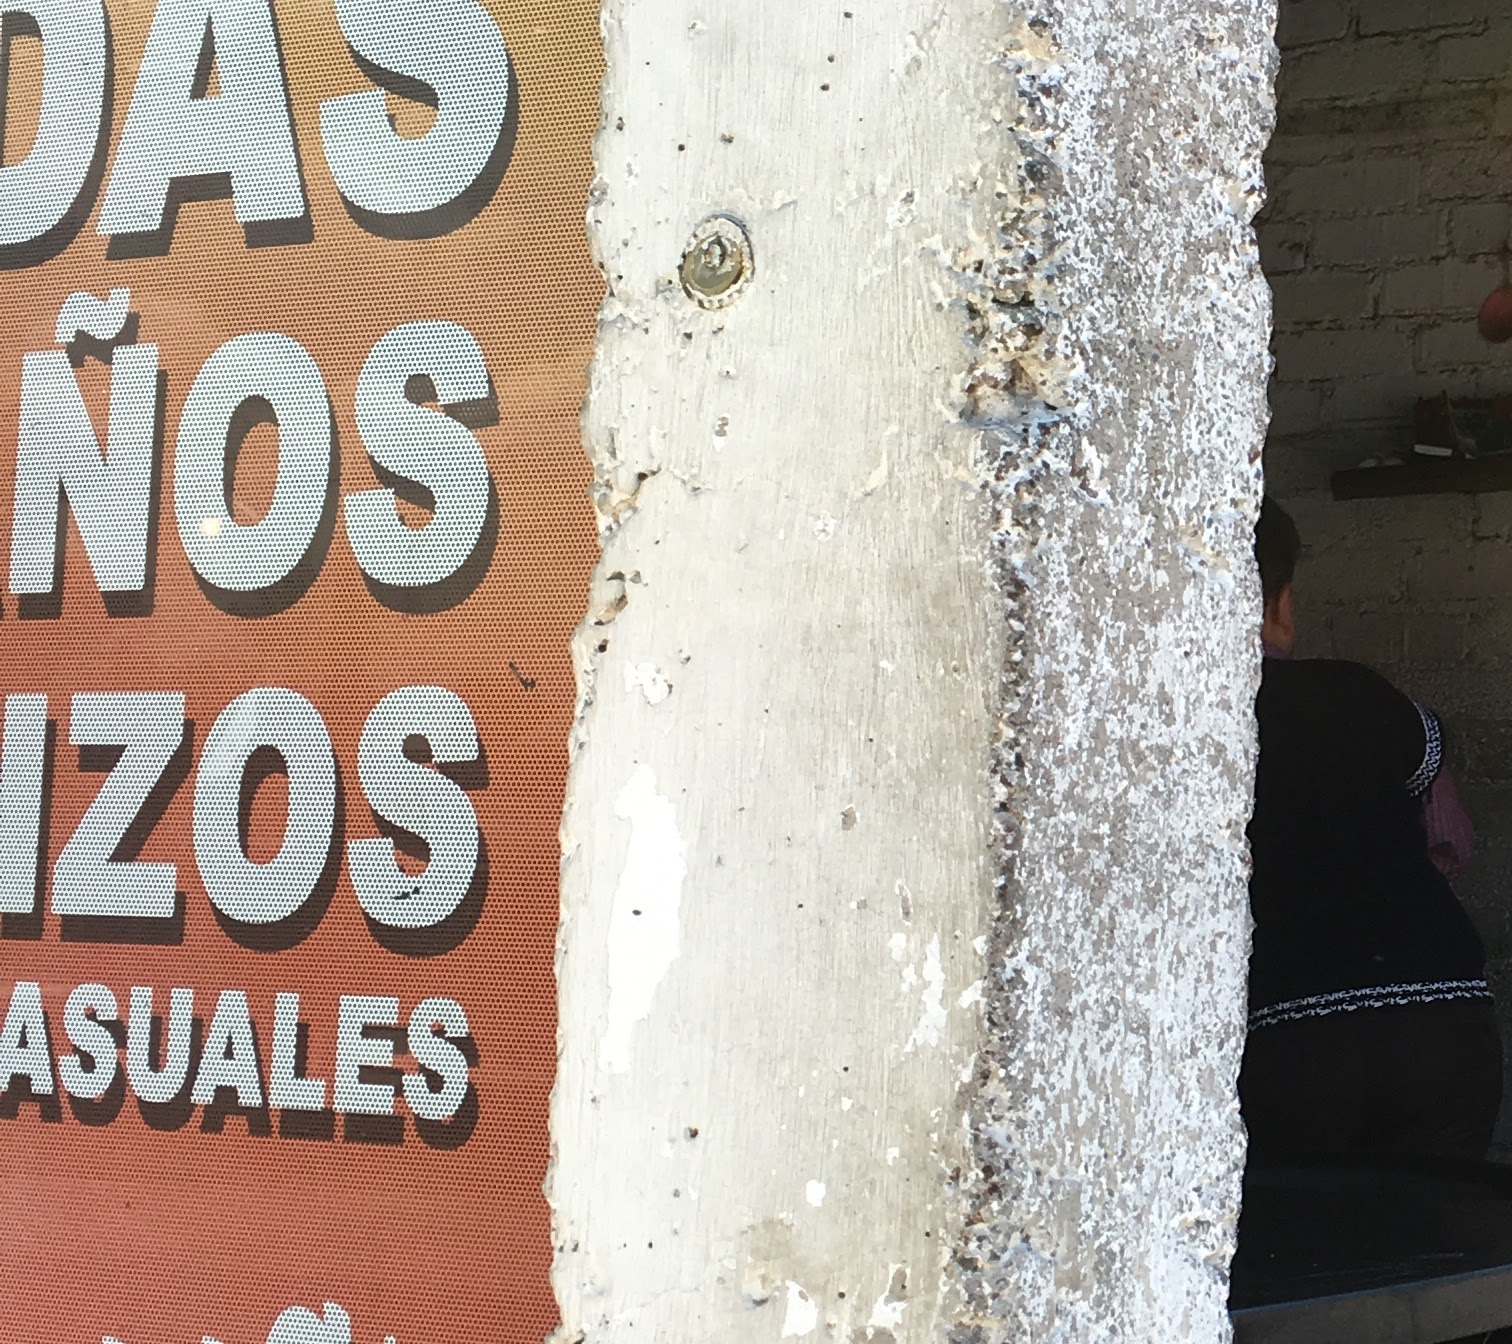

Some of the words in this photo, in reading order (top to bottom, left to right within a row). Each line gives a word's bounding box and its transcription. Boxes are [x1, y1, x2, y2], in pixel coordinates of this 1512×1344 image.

[8, 288, 490, 591] ÑOS
[0, 684, 480, 929] IZOS
[0, 981, 470, 1122] ASUALES
